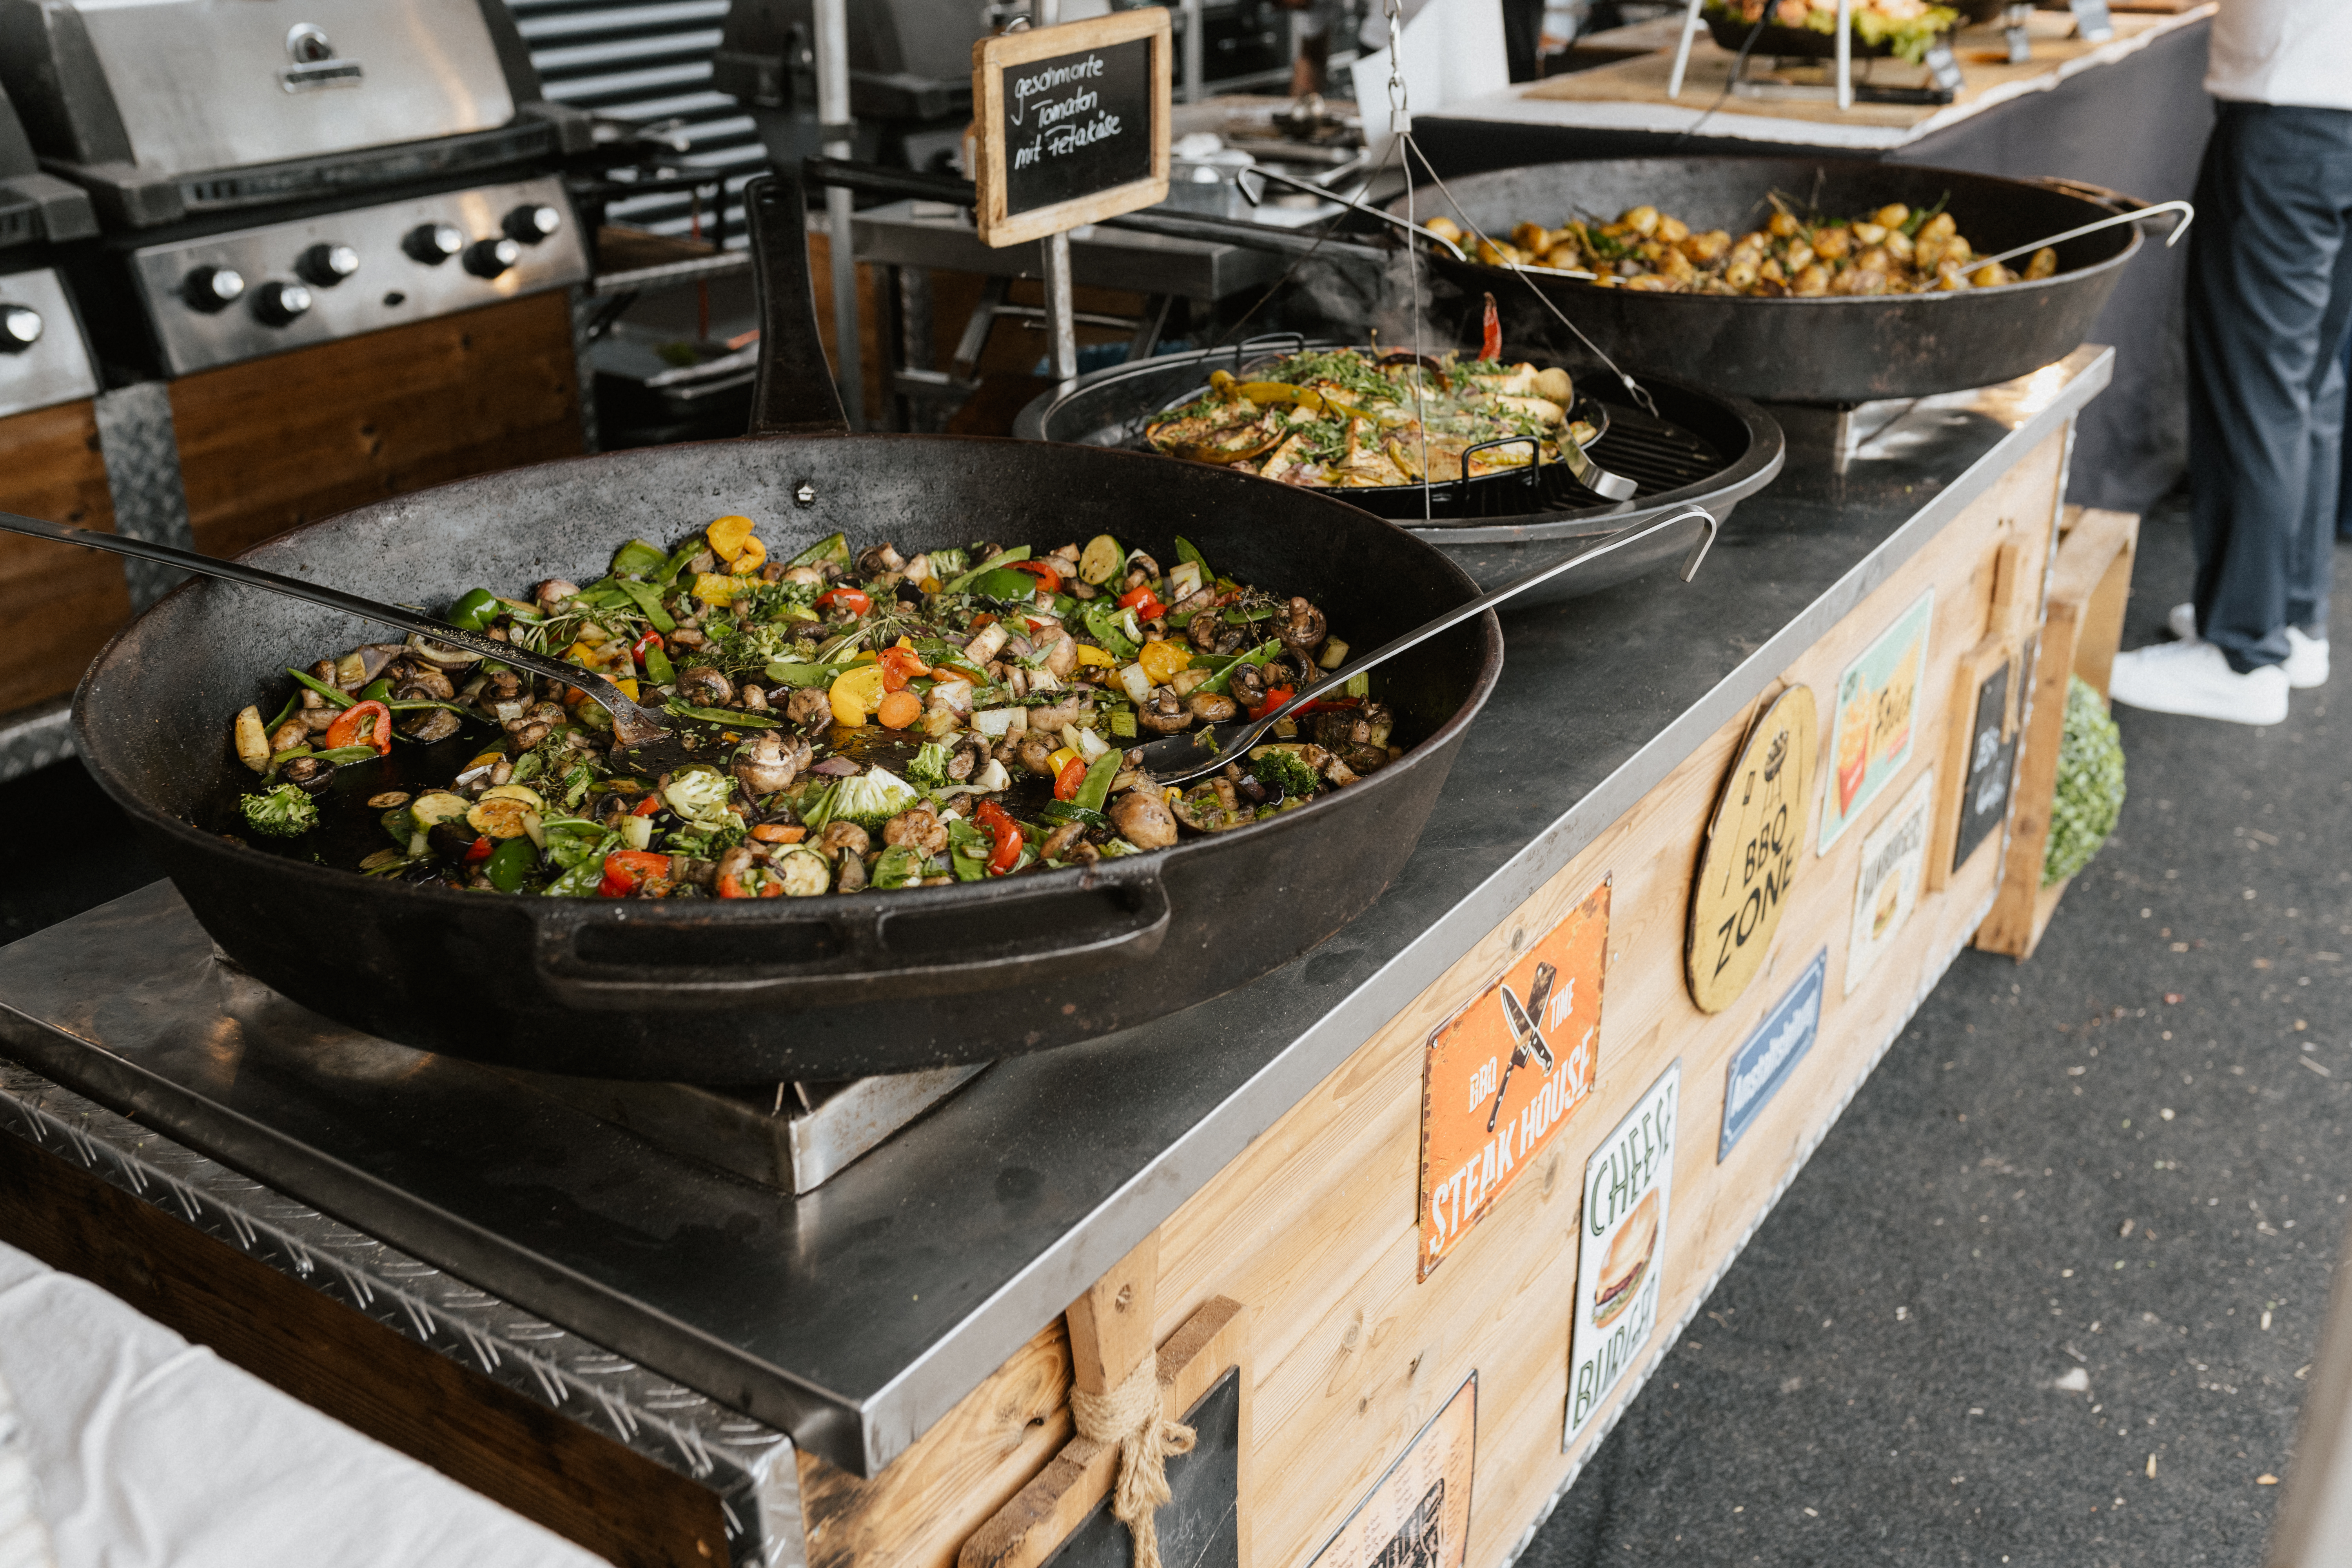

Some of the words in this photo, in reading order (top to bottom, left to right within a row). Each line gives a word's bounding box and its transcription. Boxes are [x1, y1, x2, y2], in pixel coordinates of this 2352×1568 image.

[1010, 54, 1104, 126] geschmorte
[1031, 85, 1098, 129] Tomaten
[1014, 134, 1042, 170] mit
[1744, 803, 1787, 889] BBQ
[1713, 832, 1795, 979] ZONE
[1468, 1056, 1498, 1114] BBQ
[1549, 977, 1576, 1034] TIME
[1428, 1118, 1517, 1257] STEAK
[1519, 1025, 1594, 1159] HOUSE
[1590, 1082, 1673, 1237] CHEESE
